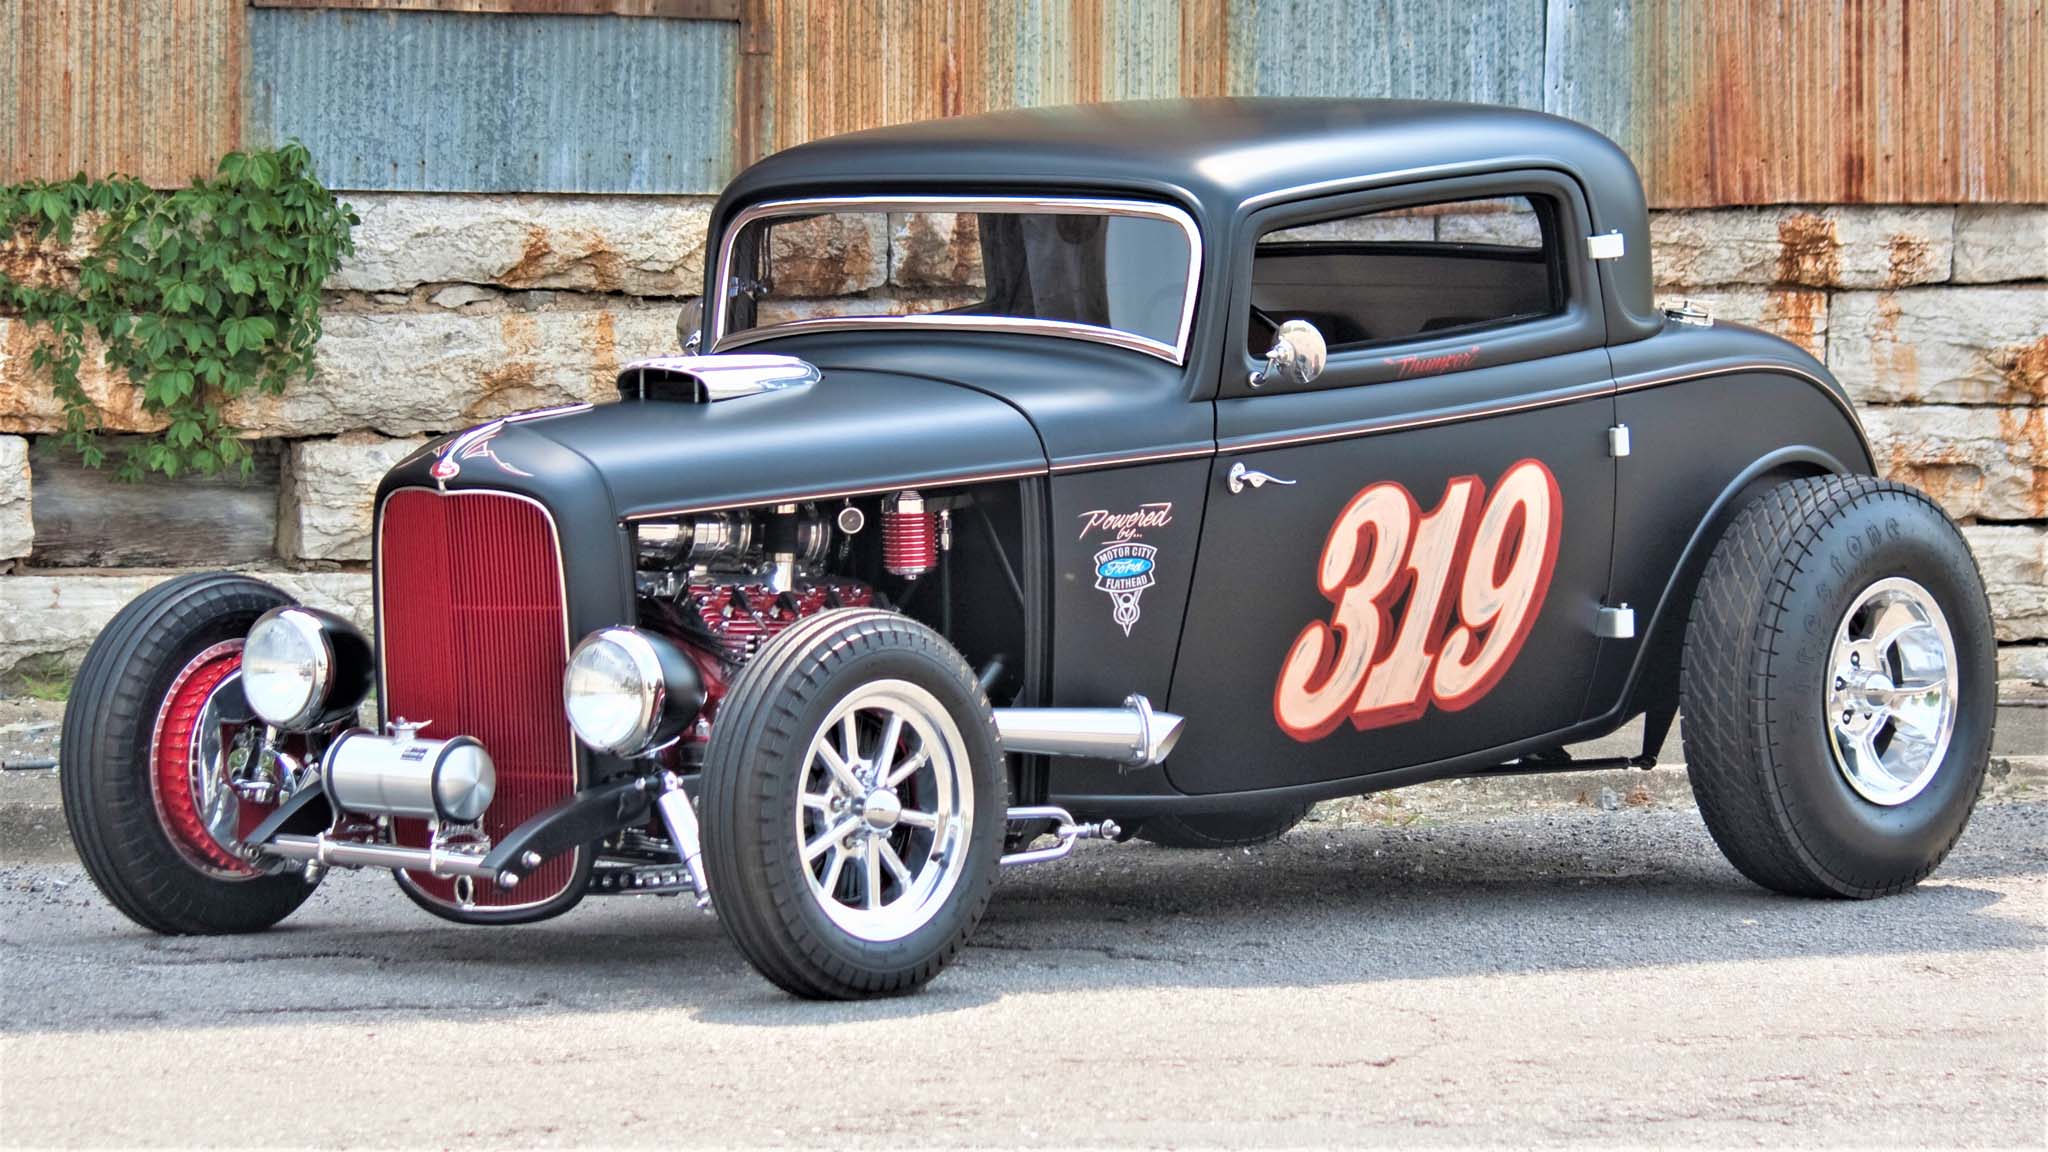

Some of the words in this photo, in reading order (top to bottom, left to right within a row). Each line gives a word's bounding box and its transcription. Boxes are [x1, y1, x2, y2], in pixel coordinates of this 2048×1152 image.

[1078, 502, 1172, 541] Powered
[1100, 547, 1130, 563] MOTOR
[1132, 546, 1152, 559] CITY
[1104, 560, 1145, 576] Ford
[1106, 575, 1148, 589] FLATHEAD
[1274, 458, 1563, 742] 319
